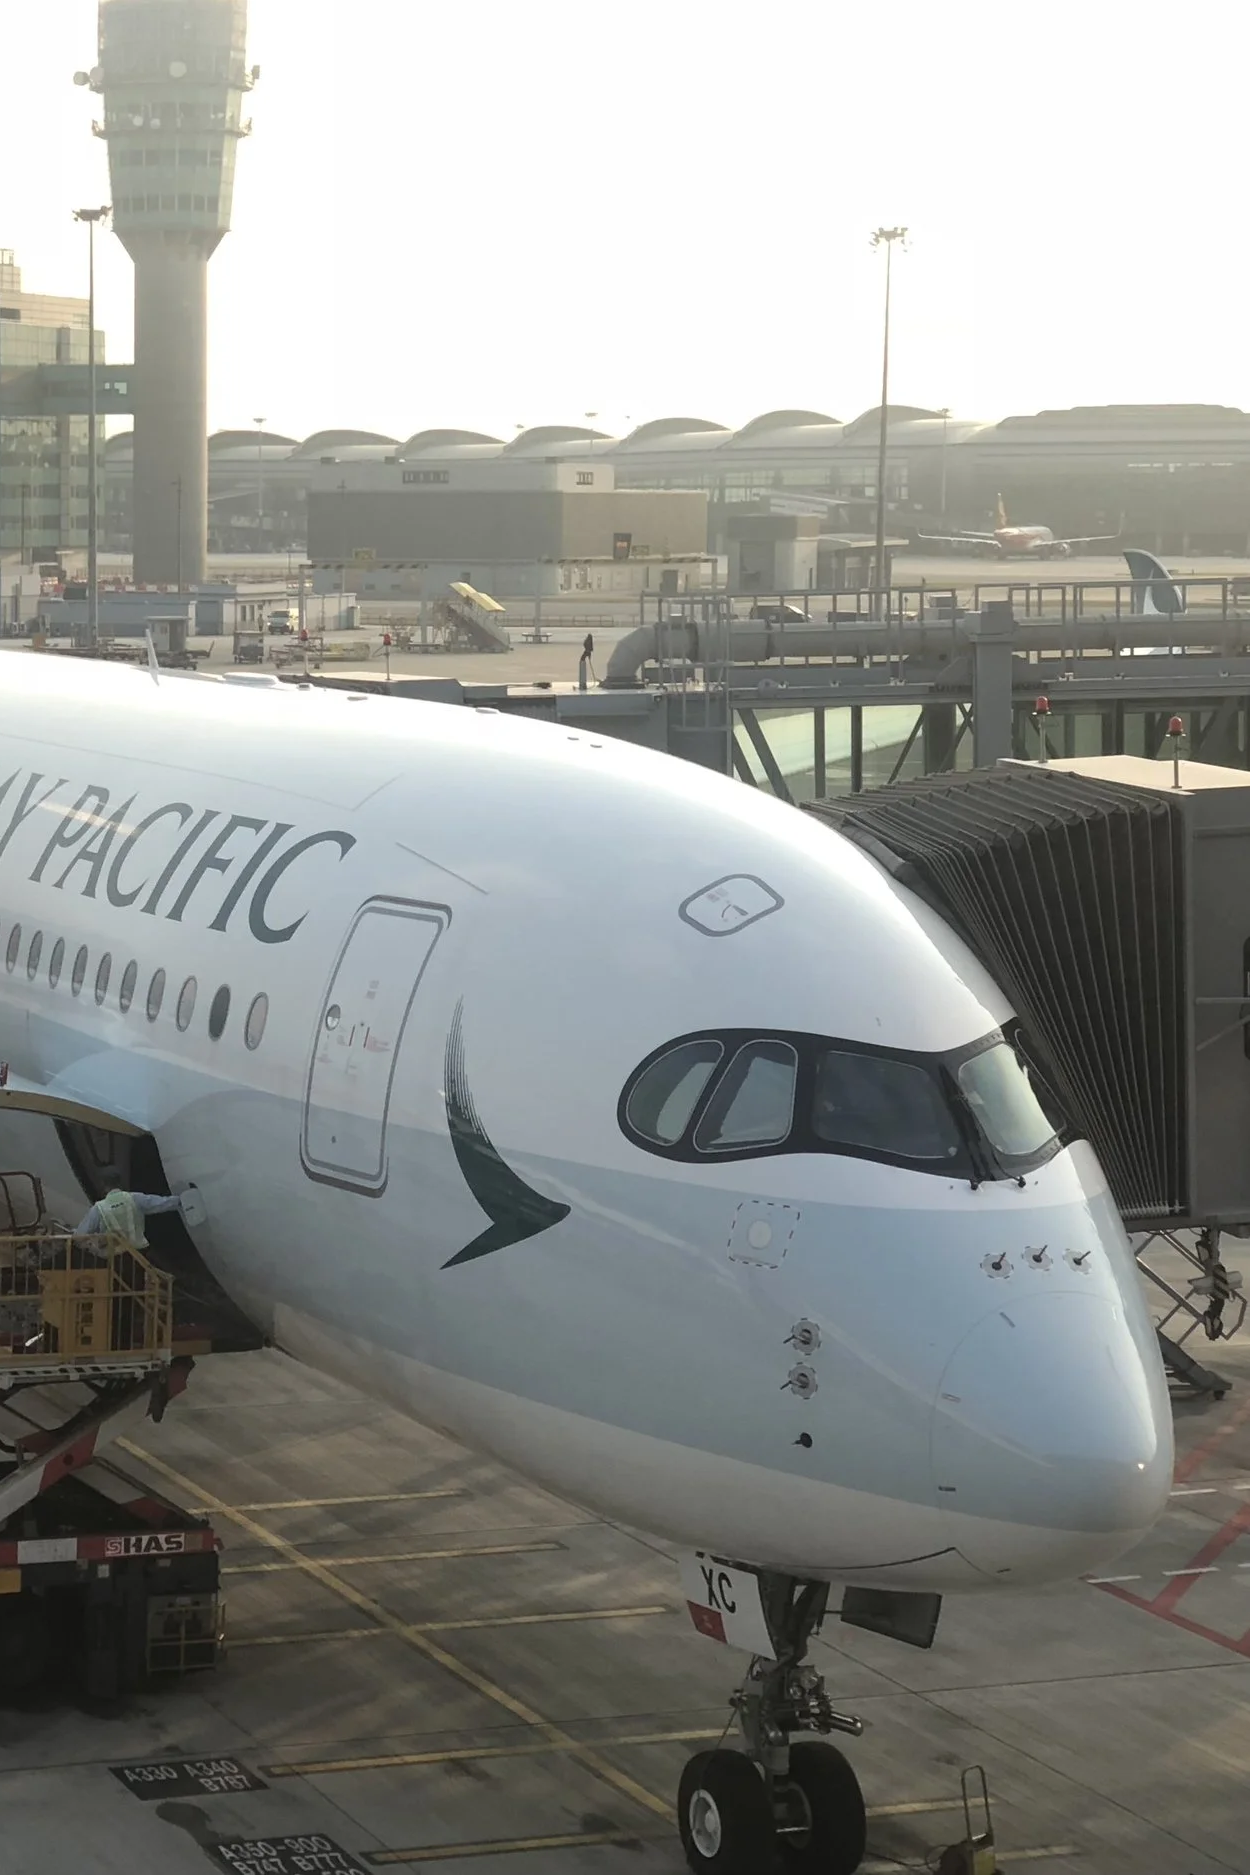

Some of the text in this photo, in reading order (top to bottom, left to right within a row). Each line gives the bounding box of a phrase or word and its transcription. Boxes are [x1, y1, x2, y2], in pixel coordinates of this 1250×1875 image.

[28, 784, 357, 944] PACIFIC
[700, 1565, 736, 1613] XC
[124, 1760, 239, 1783] A330 A340
[199, 1774, 251, 1792] B787
[291, 1852, 348, 1871] B777
